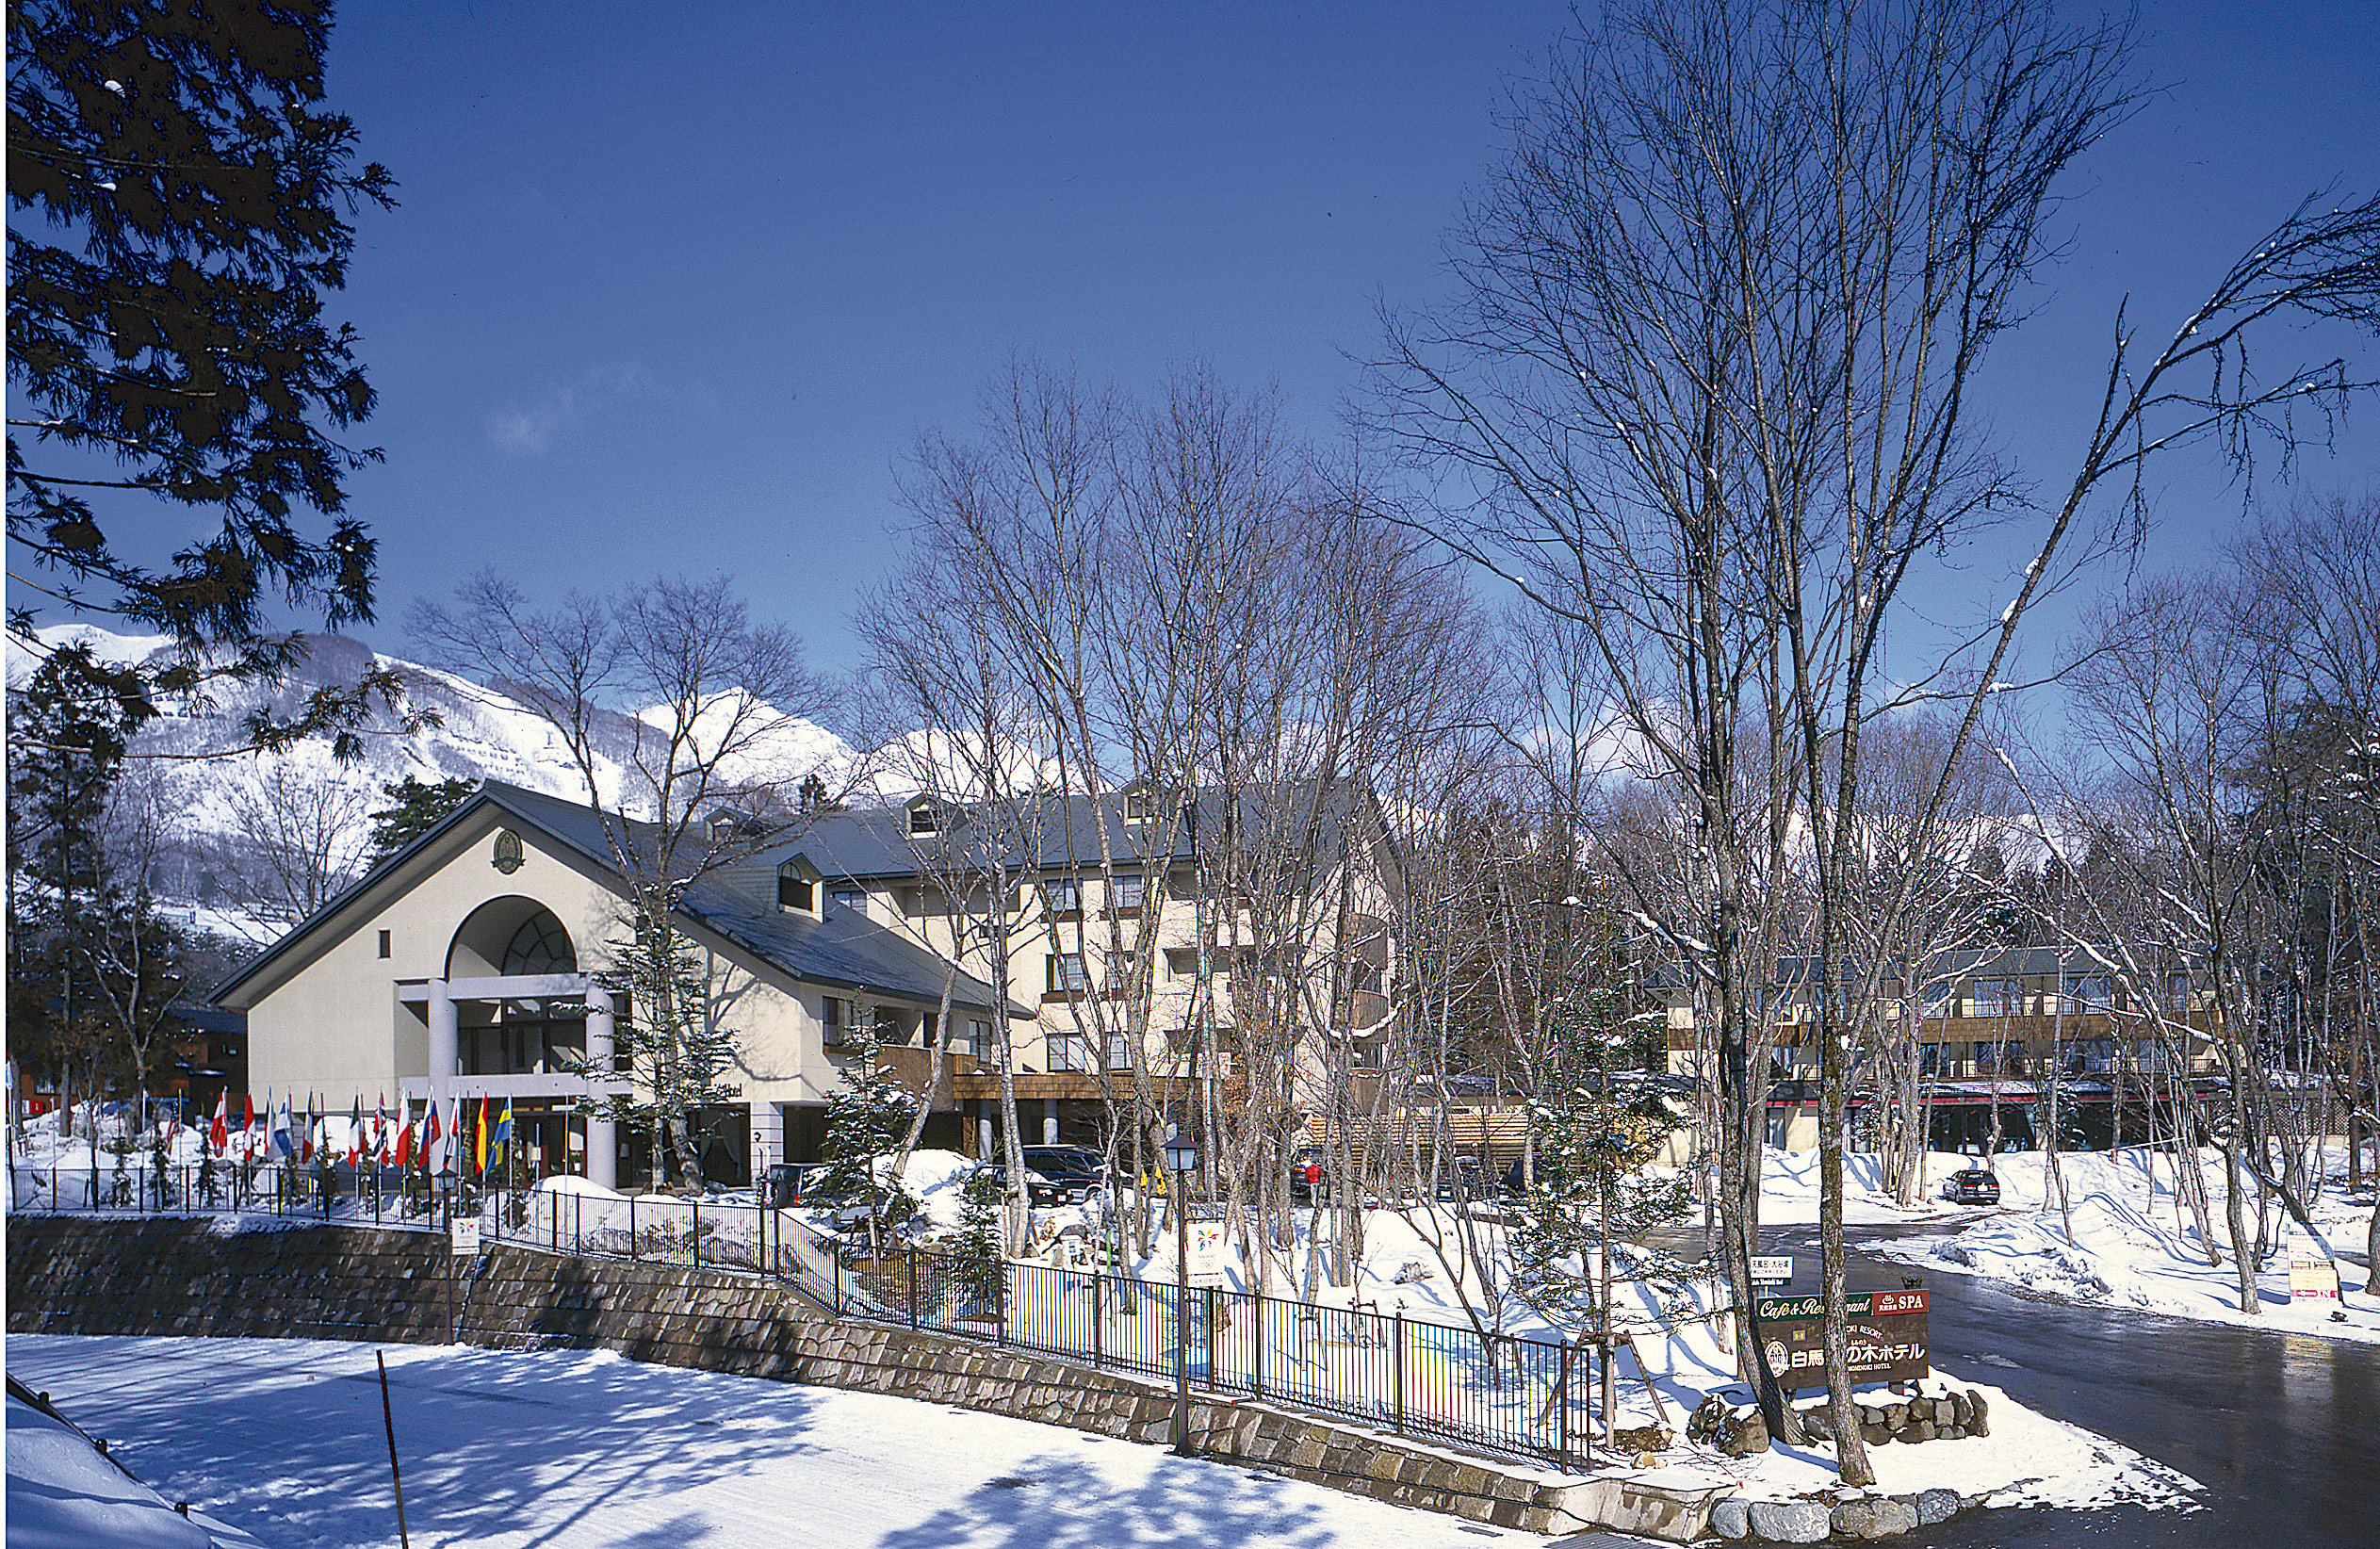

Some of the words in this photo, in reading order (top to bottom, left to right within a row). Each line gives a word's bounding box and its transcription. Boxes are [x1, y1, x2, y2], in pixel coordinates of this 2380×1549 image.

[1790, 1302, 1800, 1316] &
[1800, 1298, 1870, 1314] Resrant
[1899, 1295, 1924, 1310] SPA
[1859, 1325, 1883, 1340] RESORT
[1874, 1362, 1891, 1371] HOTEL
